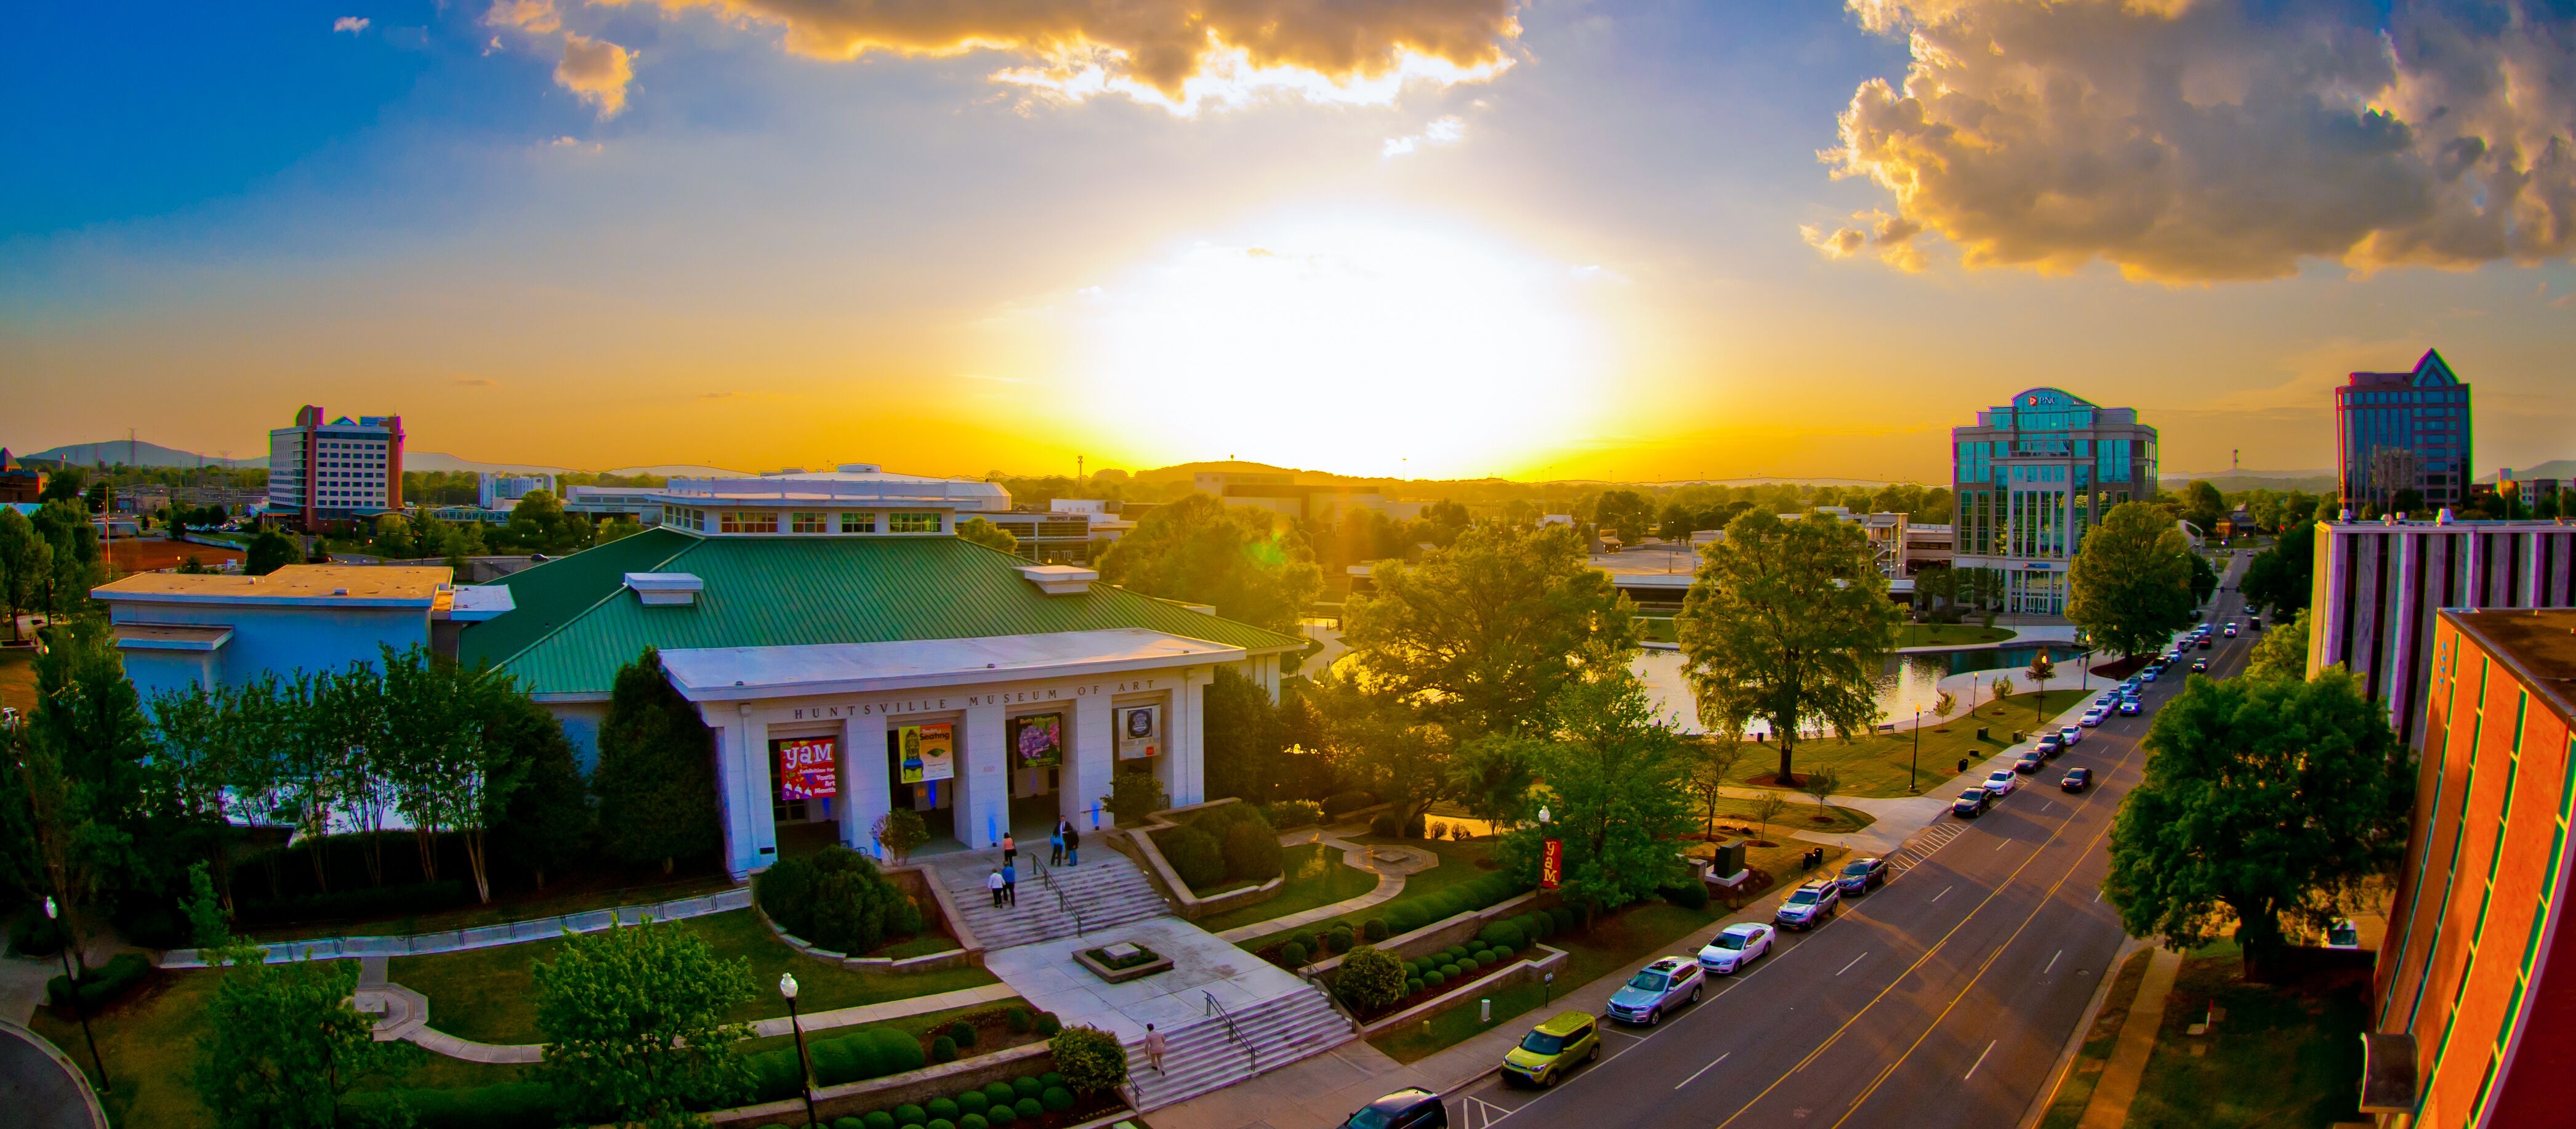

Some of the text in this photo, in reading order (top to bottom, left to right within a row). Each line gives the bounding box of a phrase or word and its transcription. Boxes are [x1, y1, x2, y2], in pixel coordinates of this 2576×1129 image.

[2039, 397, 2058, 405] PNC
[795, 679, 1154, 719] HUNTSVILLE MUSEUM OF ART
[920, 732, 950, 740] Seating
